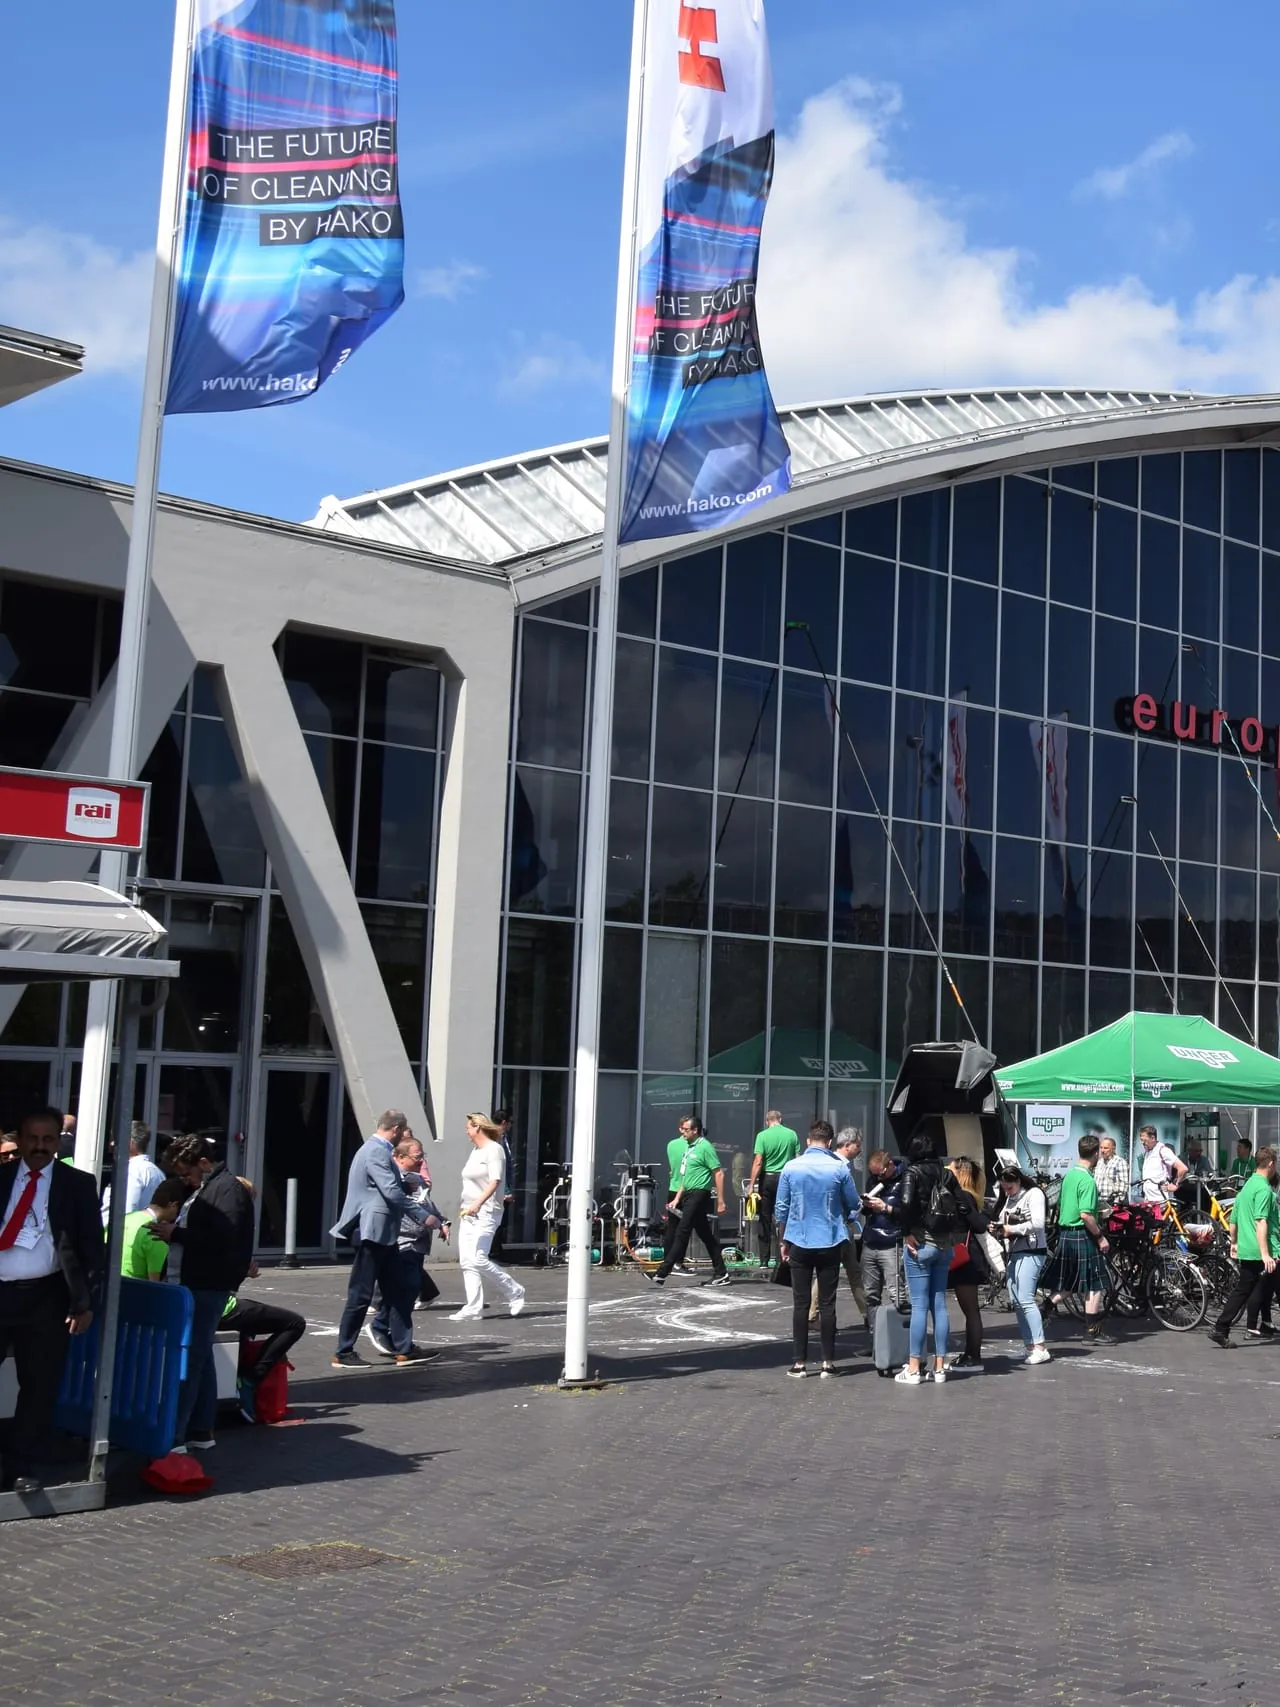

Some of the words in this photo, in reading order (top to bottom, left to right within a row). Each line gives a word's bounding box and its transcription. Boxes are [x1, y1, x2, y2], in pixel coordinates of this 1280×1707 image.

[217, 131, 275, 158] THE
[285, 126, 392, 156] FUTURE
[203, 173, 239, 200] OF
[251, 168, 392, 200] CLEANING
[268, 217, 307, 241] BY
[315, 209, 392, 236] HAKO
[701, 283, 756, 315] FUTUR
[673, 320, 750, 353] CLEANIN
[639, 483, 772, 520] www.hako.com
[75, 803, 112, 819] rai
[1172, 1047, 1235, 1066] UNGER
[1142, 1081, 1171, 1096] UNGER
[1033, 1118, 1064, 1131] UNGER
